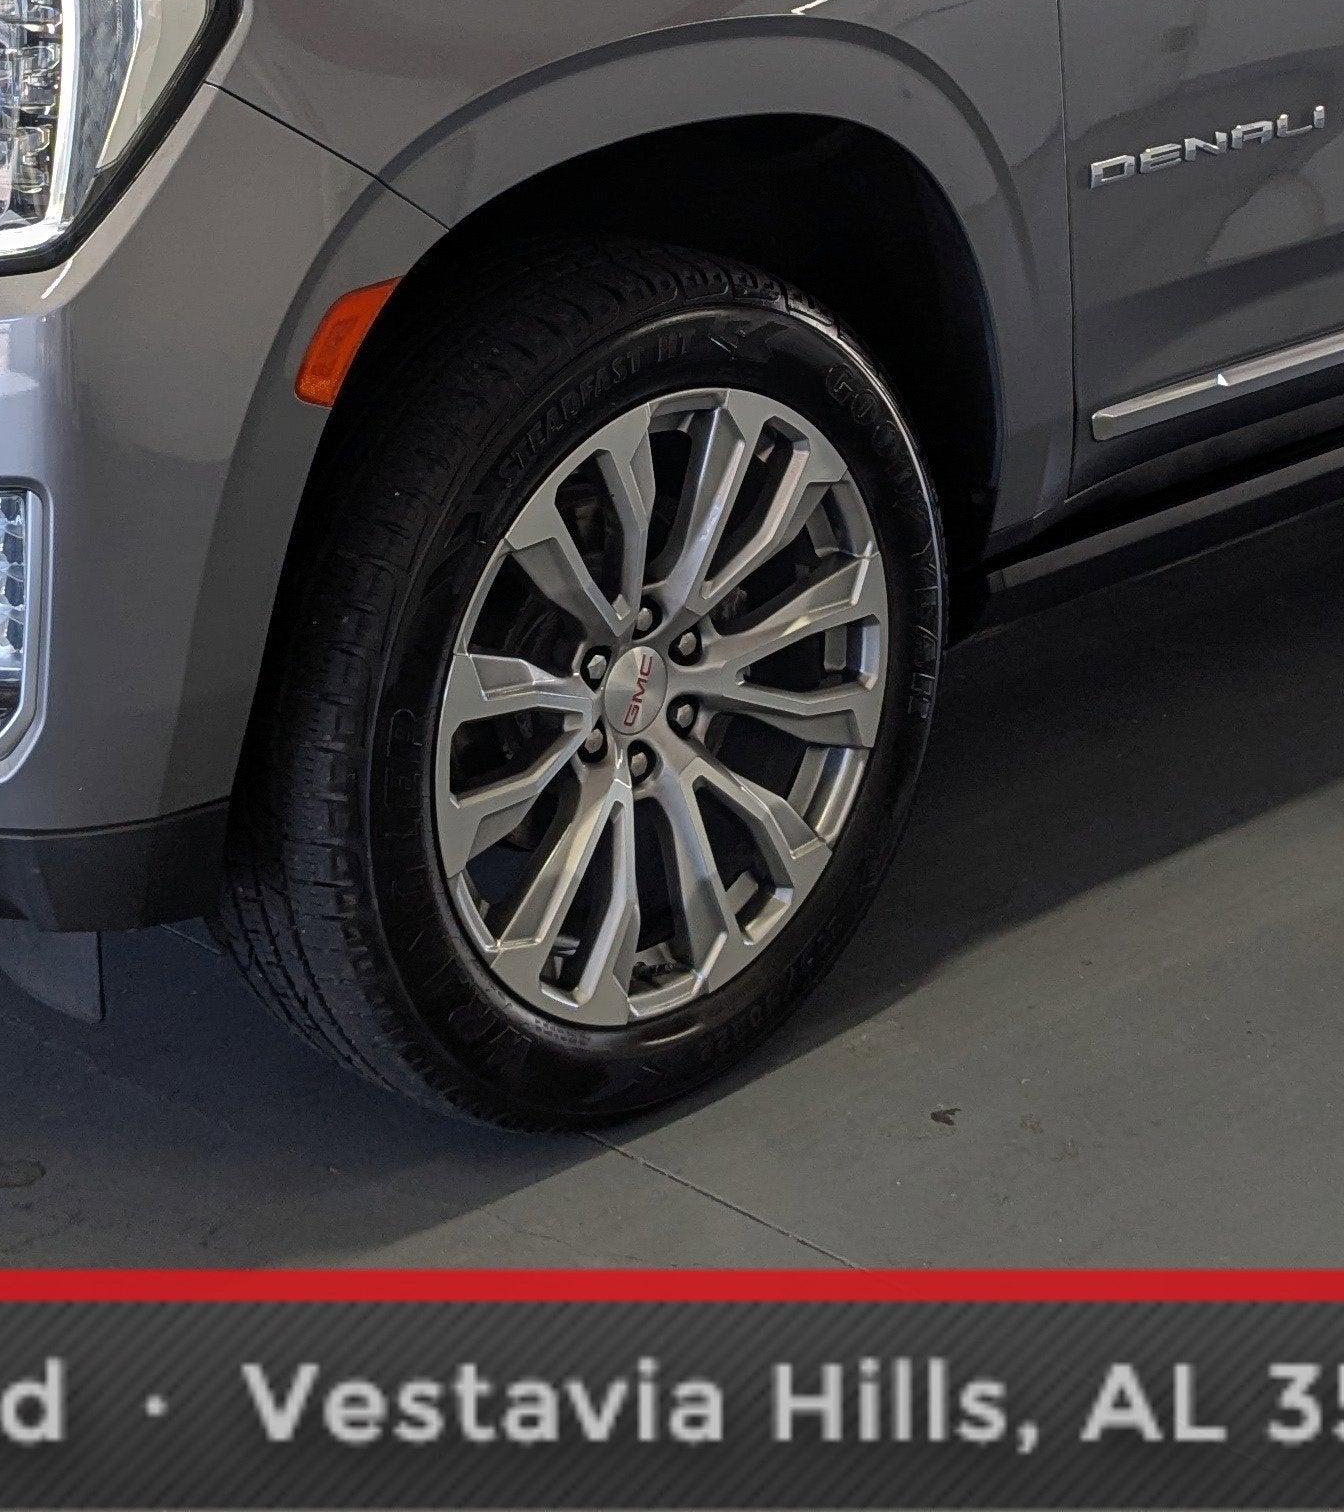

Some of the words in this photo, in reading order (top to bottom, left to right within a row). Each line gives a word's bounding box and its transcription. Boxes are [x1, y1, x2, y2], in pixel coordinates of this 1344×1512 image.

[1090, 105, 1325, 188] DENALI
[498, 347, 642, 489] STEADFAST
[623, 653, 653, 727] GMC
